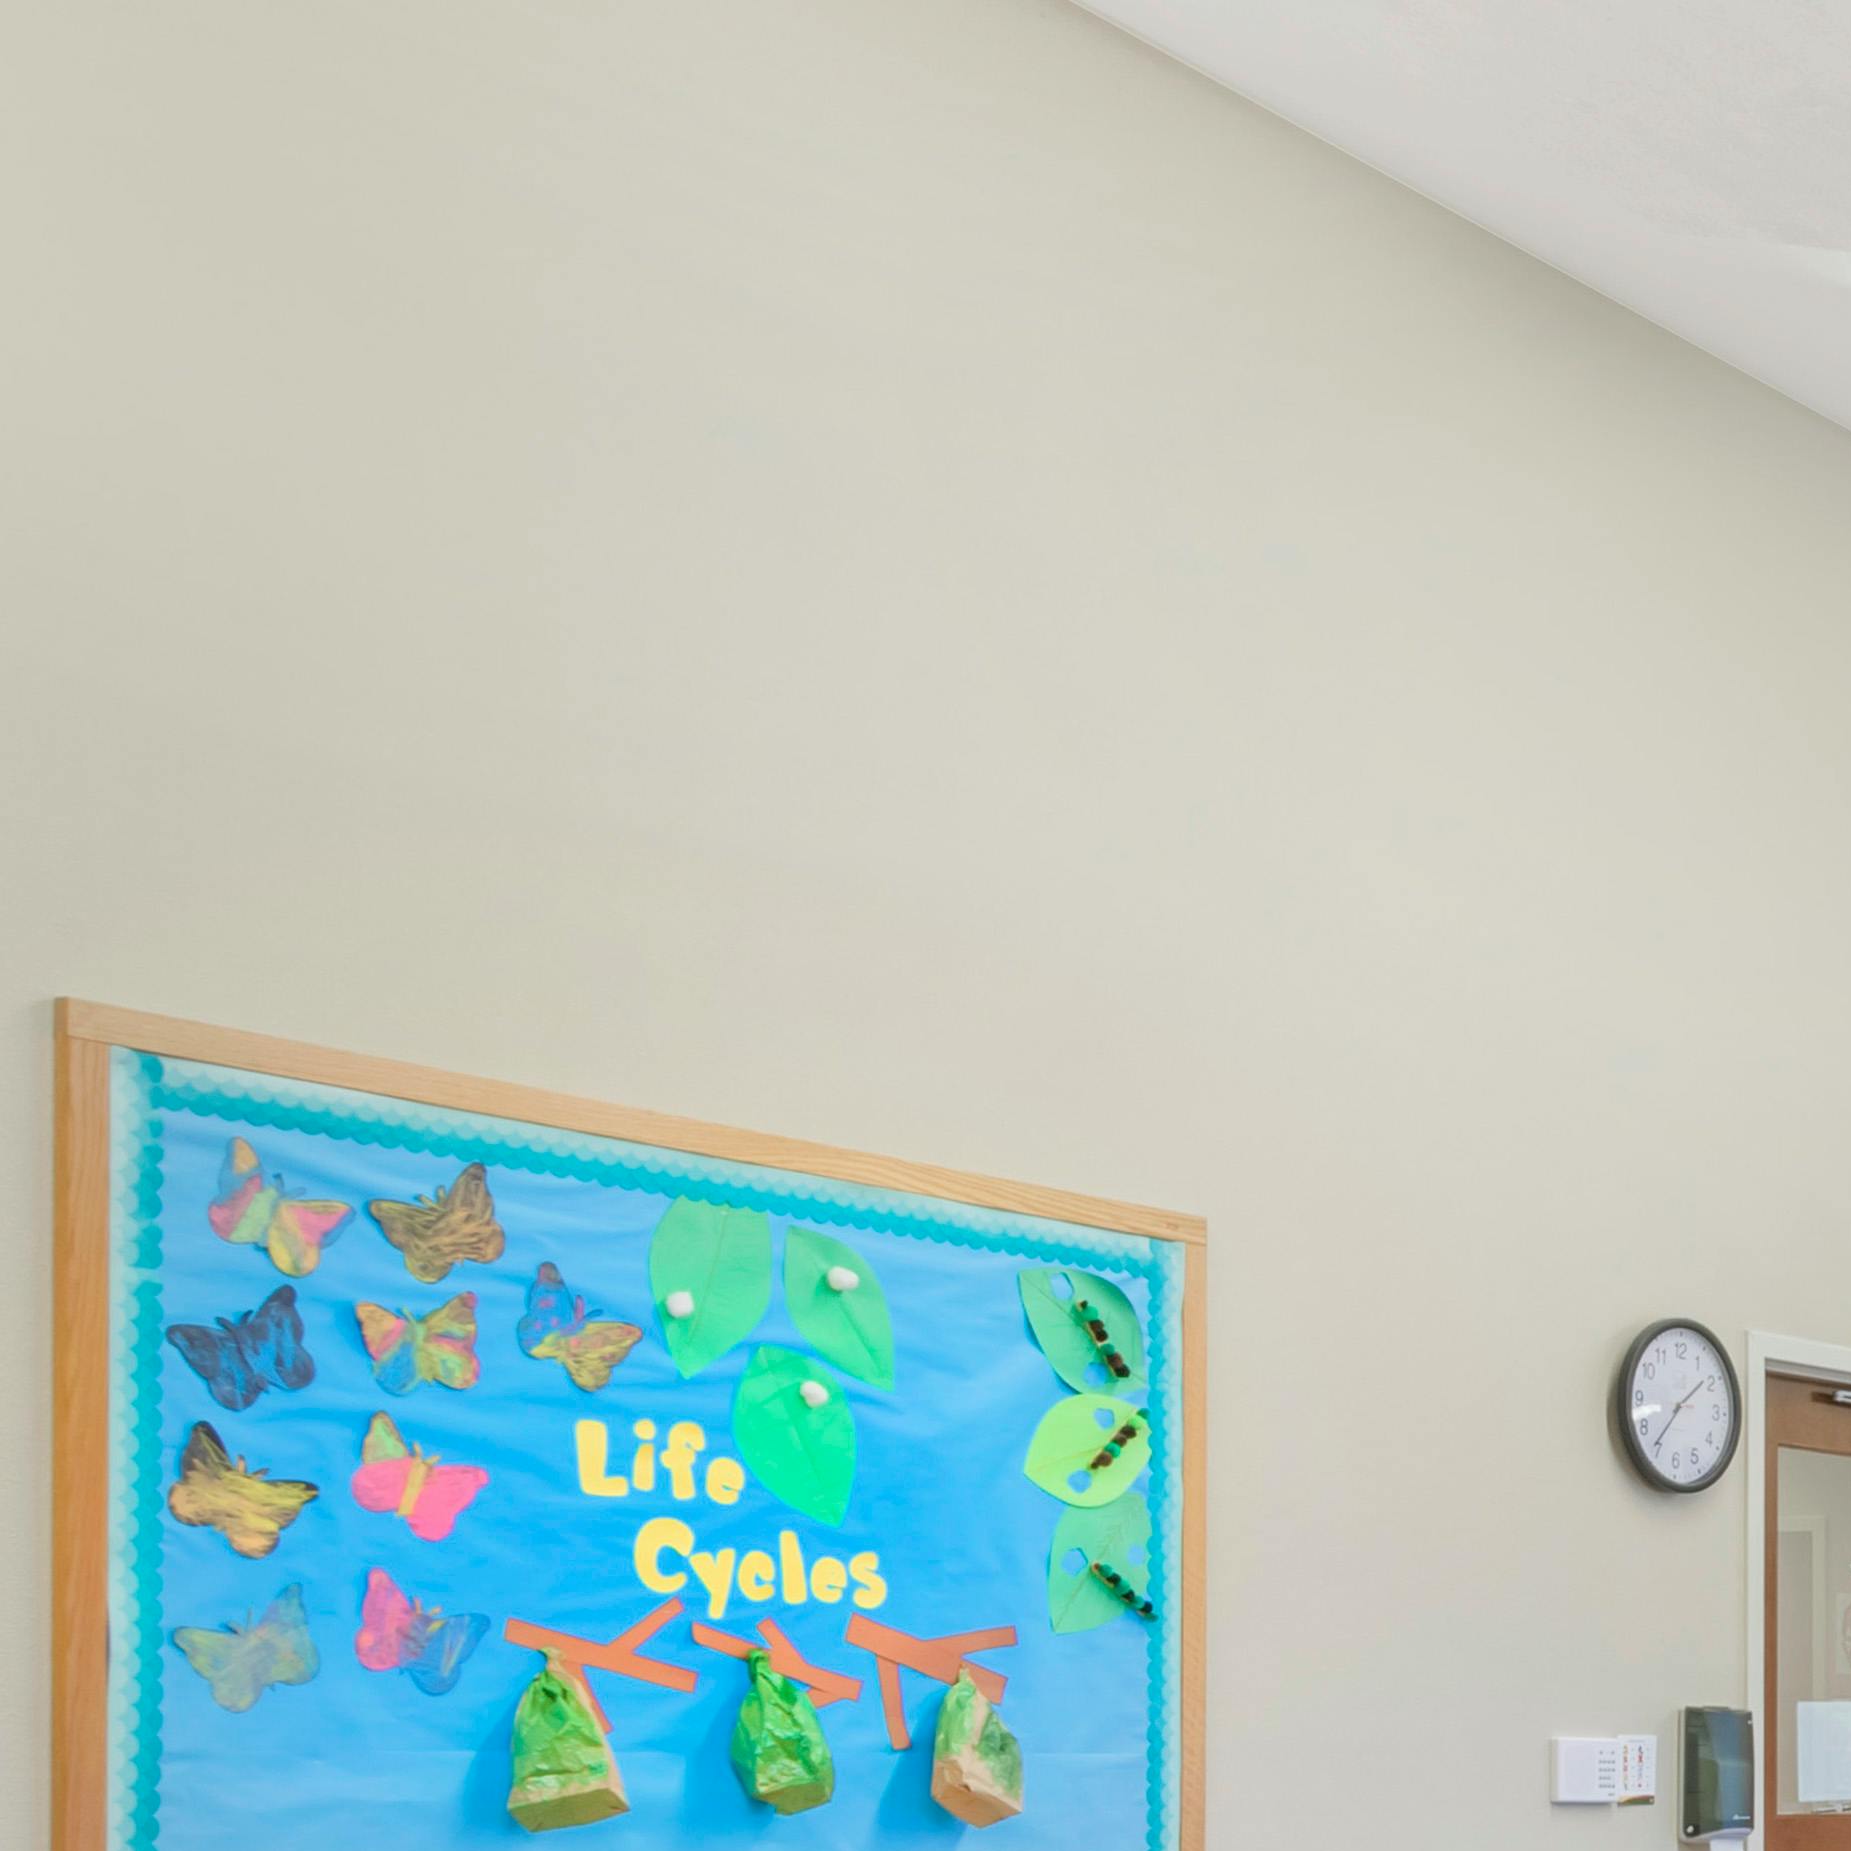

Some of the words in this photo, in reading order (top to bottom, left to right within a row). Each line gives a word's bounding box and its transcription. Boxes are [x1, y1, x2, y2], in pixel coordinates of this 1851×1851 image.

[1655, 1348, 1666, 1365] 11
[1675, 1342, 1687, 1359] 12
[1642, 1363, 1655, 1380] 10
[1696, 1357, 1700, 1371] 1
[1707, 1375, 1715, 1392] 2
[1635, 1390, 1643, 1406] 9
[1712, 1404, 1720, 1421] 3
[1640, 1418, 1648, 1435] 8
[1705, 1430, 1713, 1446] 4
[1654, 1441, 1662, 1458] 7
[1691, 1448, 1699, 1465] 5
[574, 1419, 744, 1507] Life
[1672, 1451, 1680, 1469] 6
[633, 1518, 887, 1620] Cycles
